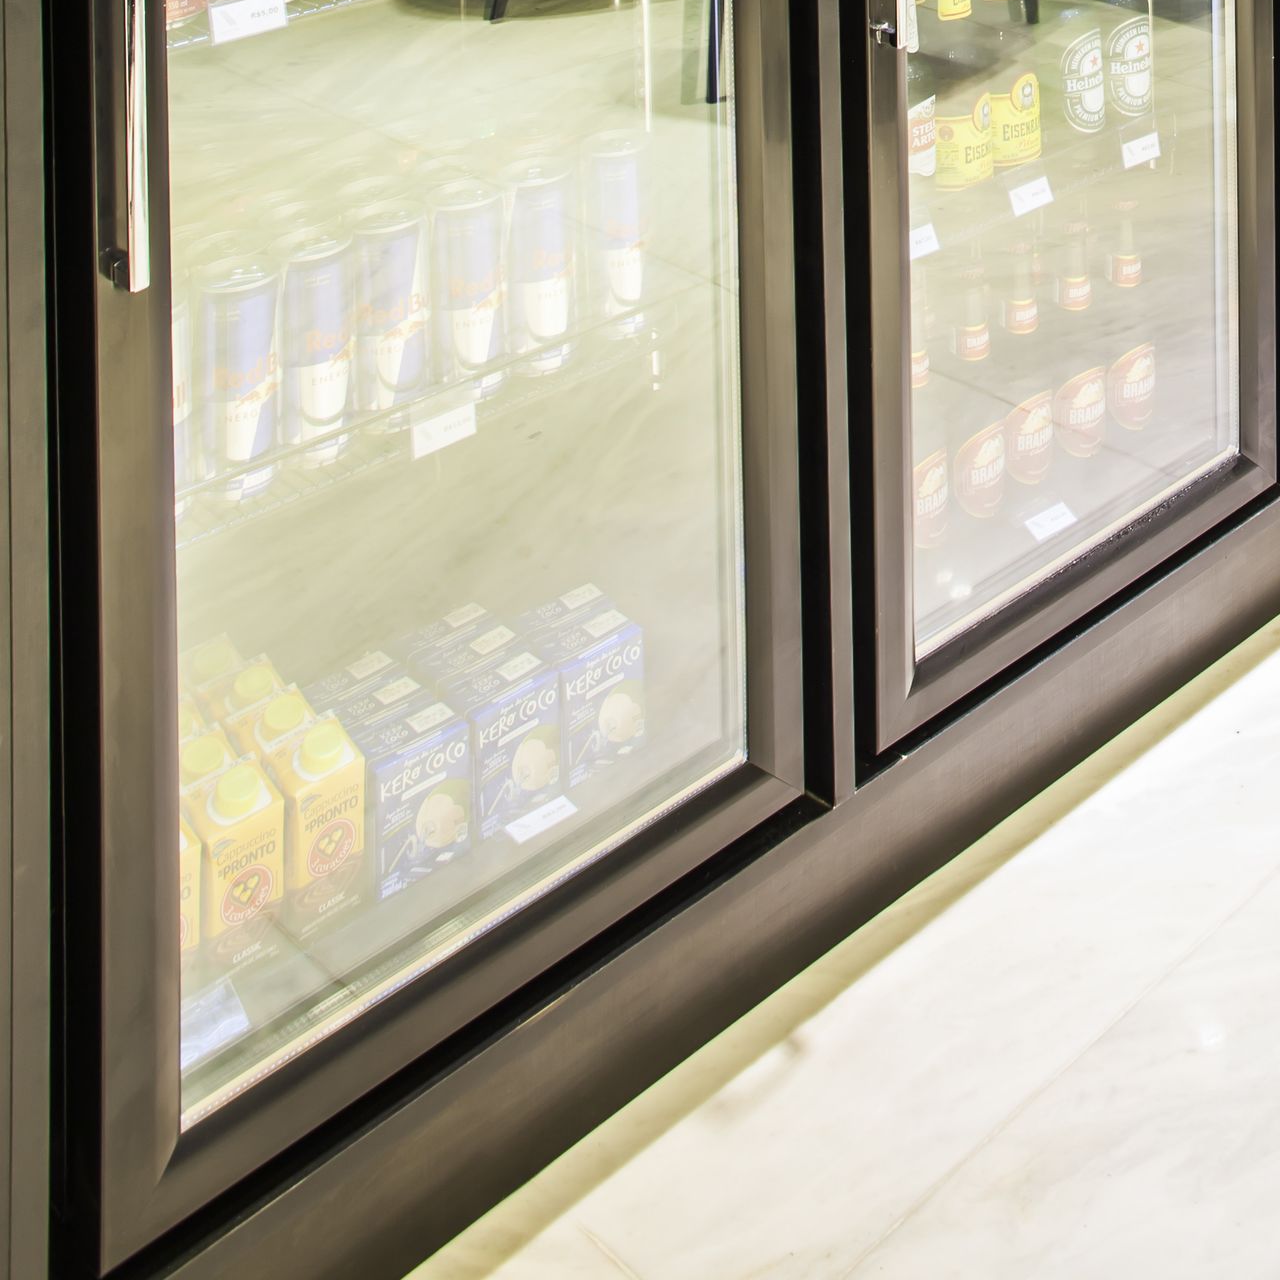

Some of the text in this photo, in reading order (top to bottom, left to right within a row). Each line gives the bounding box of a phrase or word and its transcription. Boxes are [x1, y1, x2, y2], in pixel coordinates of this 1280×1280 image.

[250, 6, 279, 19] R$5,00
[303, 783, 360, 820] Cappuccino
[216, 827, 277, 867] Cappuccino
